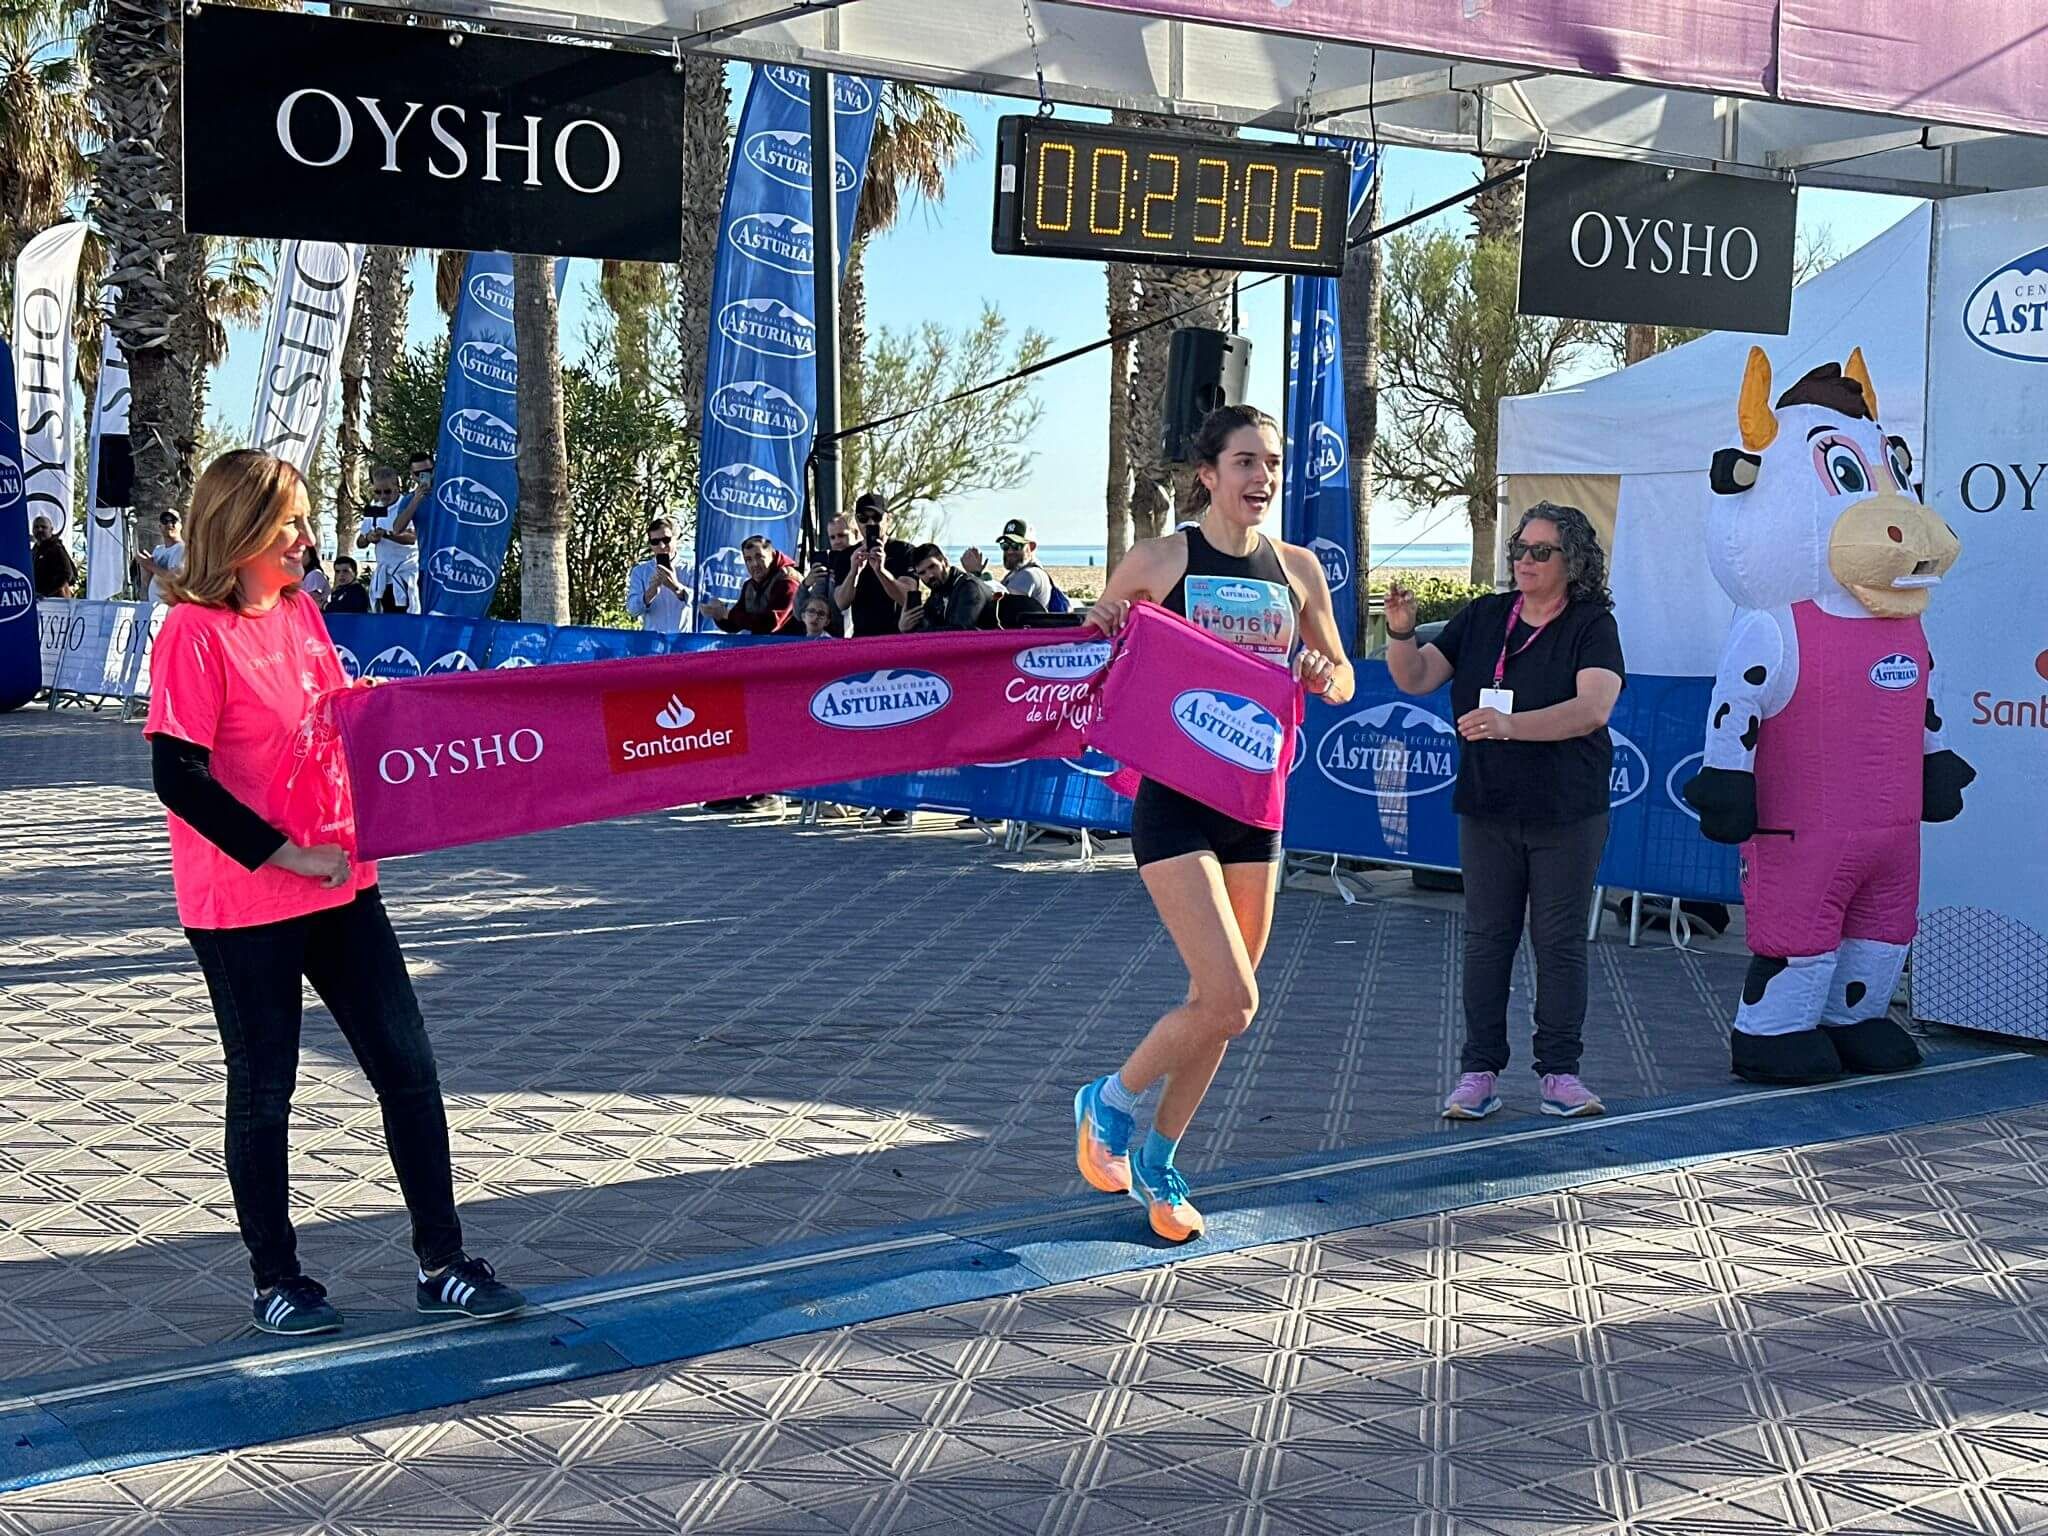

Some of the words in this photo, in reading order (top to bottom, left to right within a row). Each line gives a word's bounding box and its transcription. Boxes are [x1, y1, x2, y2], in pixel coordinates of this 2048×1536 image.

[276, 87, 621, 194] OYSHO
[1036, 142, 1325, 251] 00:23:06
[736, 223, 814, 264] ASTURIA
[1570, 211, 1759, 281] OYSHO
[474, 279, 514, 310] ASTUR
[261, 240, 350, 450] YSHO
[715, 394, 799, 433] ASTURIANA
[40, 615, 85, 651] YSHO
[116, 619, 158, 655] OYS
[1222, 614, 1261, 633] 016
[1023, 650, 1105, 669] ASTURIAN
[821, 688, 941, 718] ASTURIANA
[1005, 677, 1090, 704] Carrera
[1026, 703, 1042, 722] de
[1046, 703, 1057, 722] la
[622, 727, 734, 761] Santander
[1178, 698, 1277, 765] ASTURIAN
[378, 728, 545, 785] OYSHO
[1326, 734, 1453, 777] ASTURIANA
